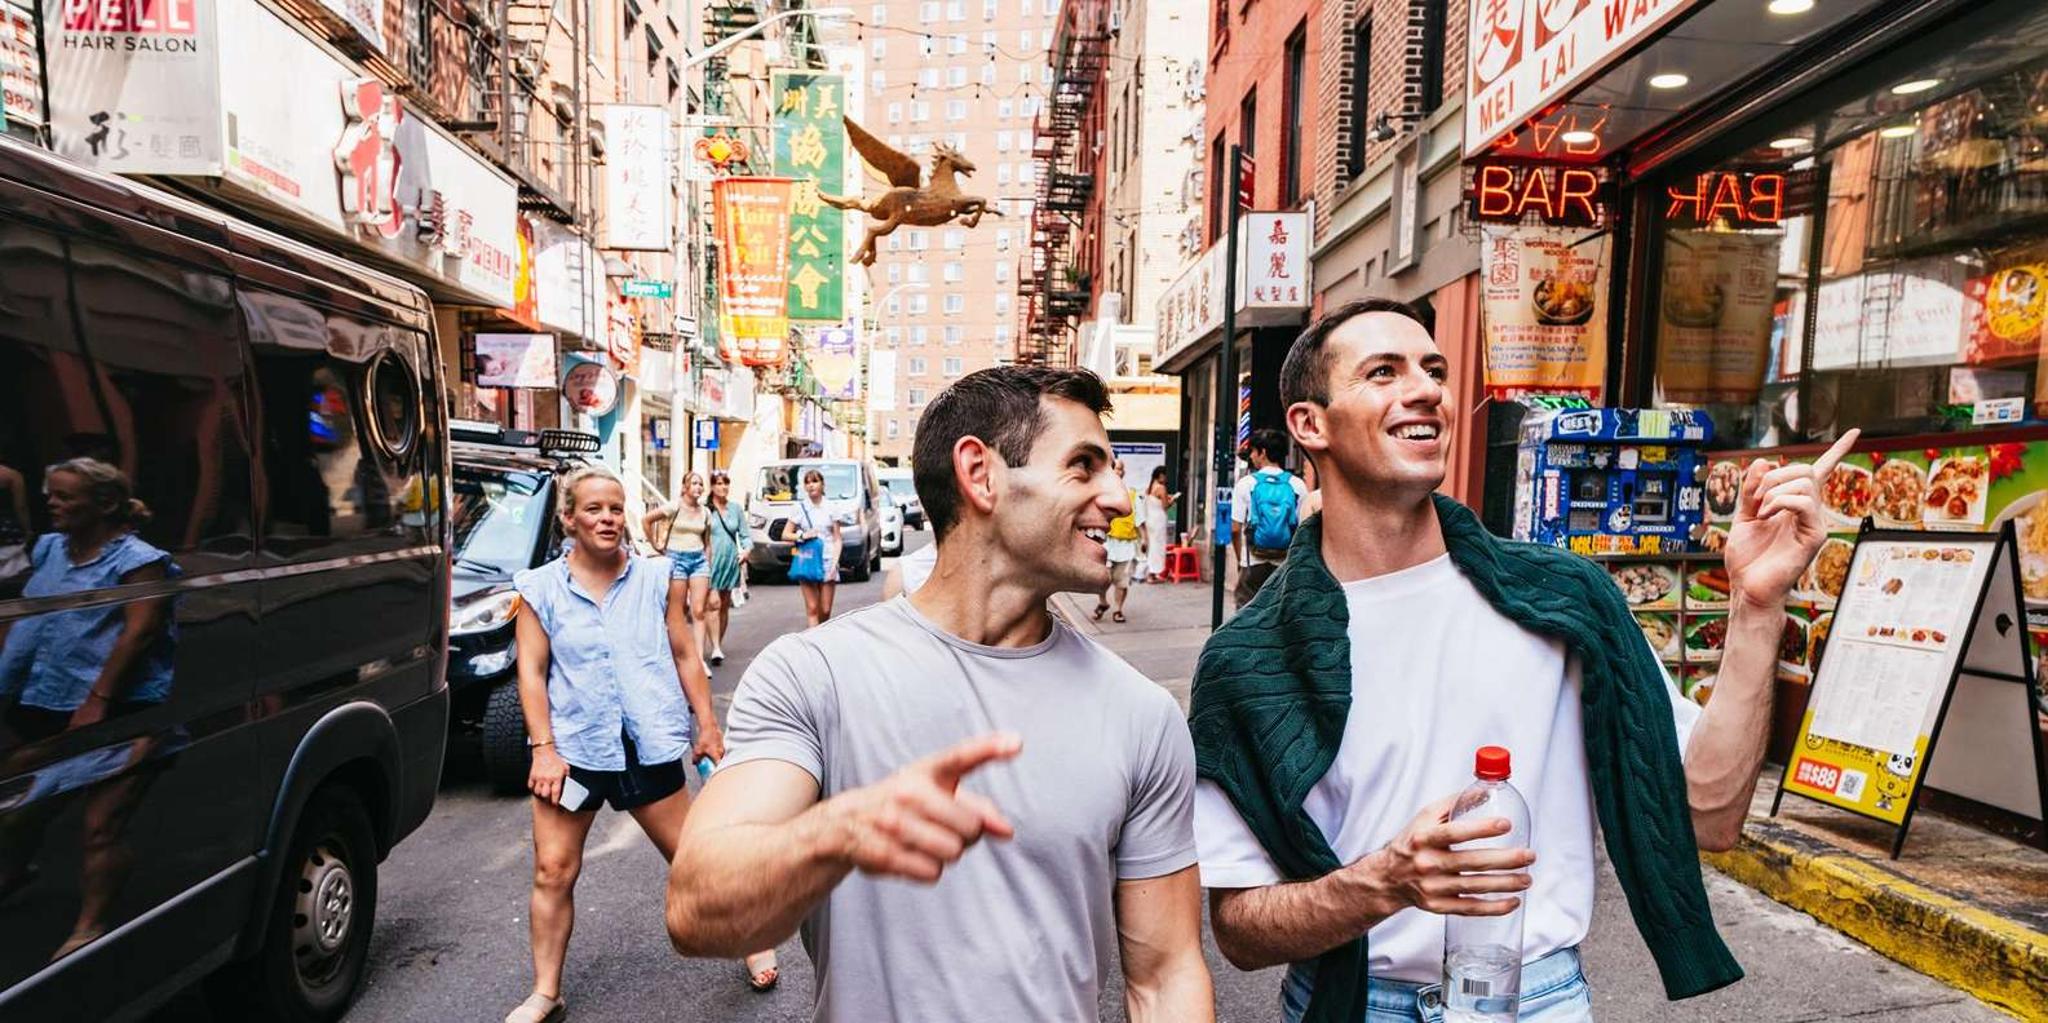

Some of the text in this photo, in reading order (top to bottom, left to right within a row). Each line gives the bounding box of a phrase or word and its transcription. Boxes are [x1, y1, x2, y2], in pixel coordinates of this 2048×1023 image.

[65, 0, 193, 30] PELL
[64, 35, 197, 53] HAIR SALON
[1479, 0, 1661, 134] MEI LAI WA
[1478, 165, 1597, 223] BAR
[1810, 765, 1838, 789] $88
